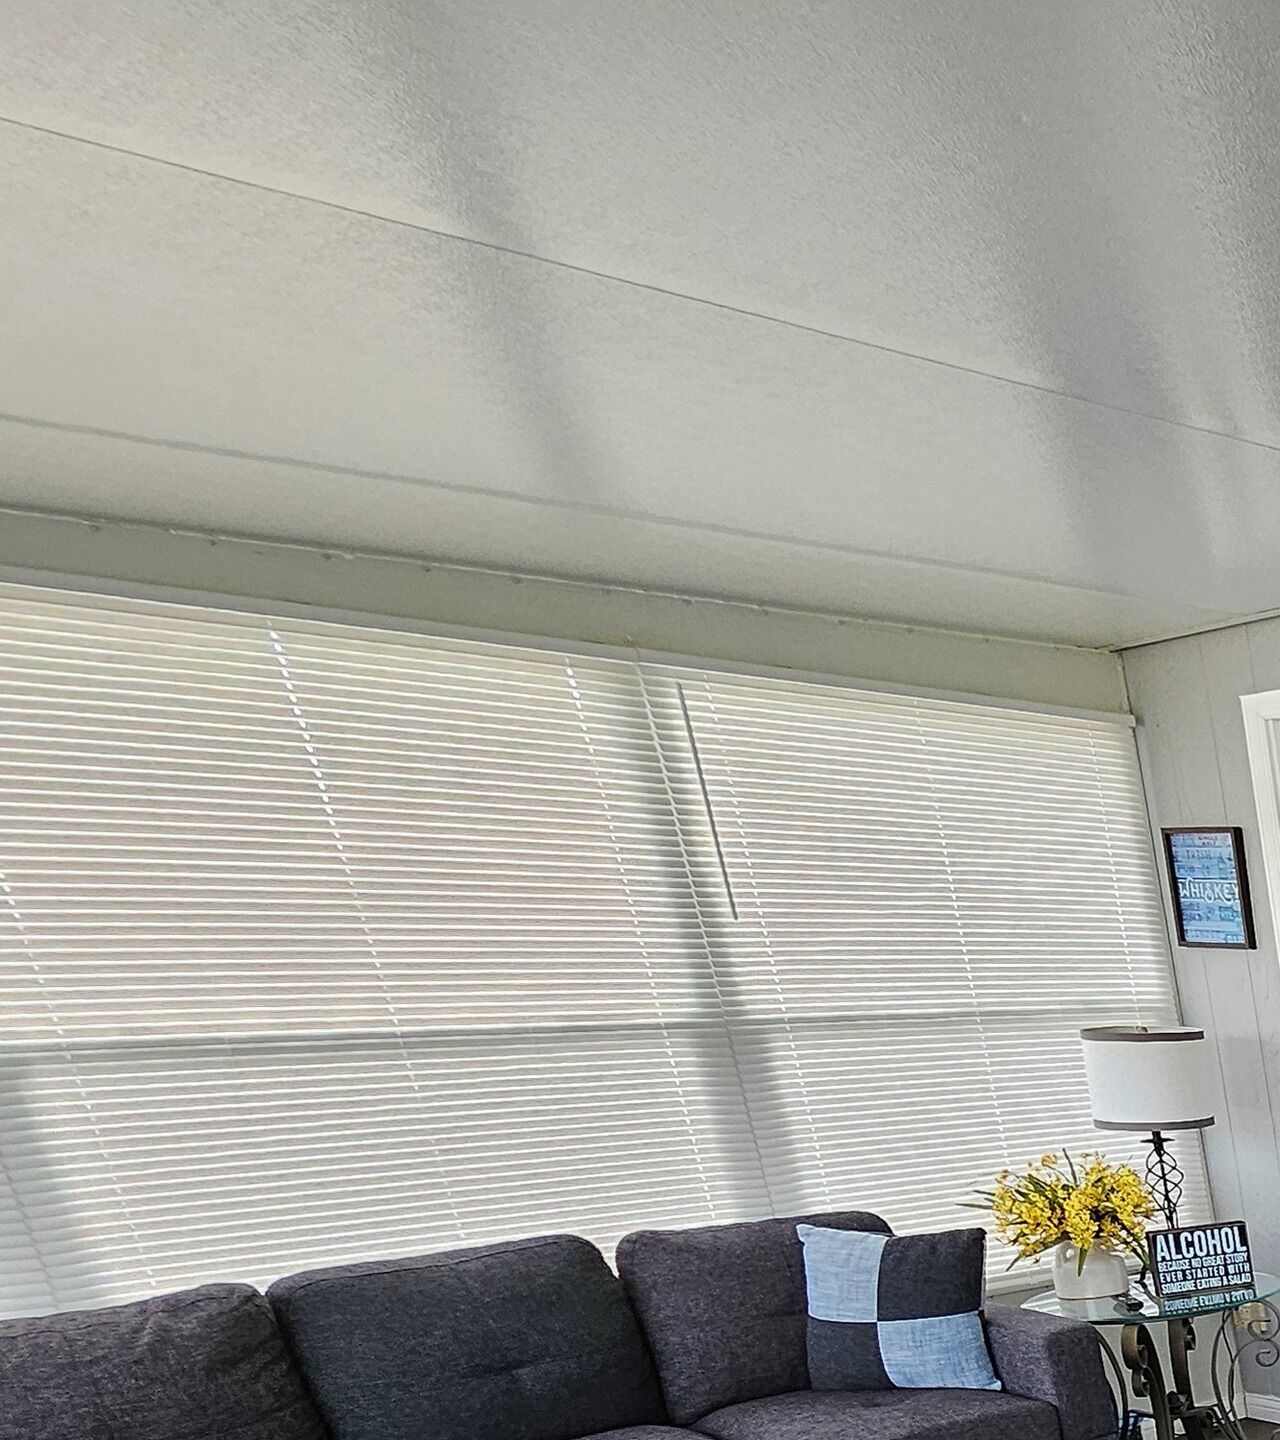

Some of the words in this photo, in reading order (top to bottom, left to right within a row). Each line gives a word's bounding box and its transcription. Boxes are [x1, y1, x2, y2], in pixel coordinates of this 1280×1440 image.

[1178, 876, 1239, 905] WHISKEY
[1156, 1226, 1247, 1261] ALCOHOL
[1158, 1259, 1191, 1272] BECAUSE
[1191, 1258, 1202, 1268] NO
[1202, 1254, 1225, 1267] GREAT
[1225, 1252, 1248, 1264] STORY
[1160, 1271, 1183, 1284] EVER
[1185, 1266, 1225, 1280] STARTED
[1227, 1262, 1250, 1275] WITH
[1161, 1280, 1197, 1295] SOMEONE
[1196, 1277, 1222, 1290] EATING
[1222, 1275, 1229, 1286] A
[1229, 1273, 1252, 1285] SALAD
